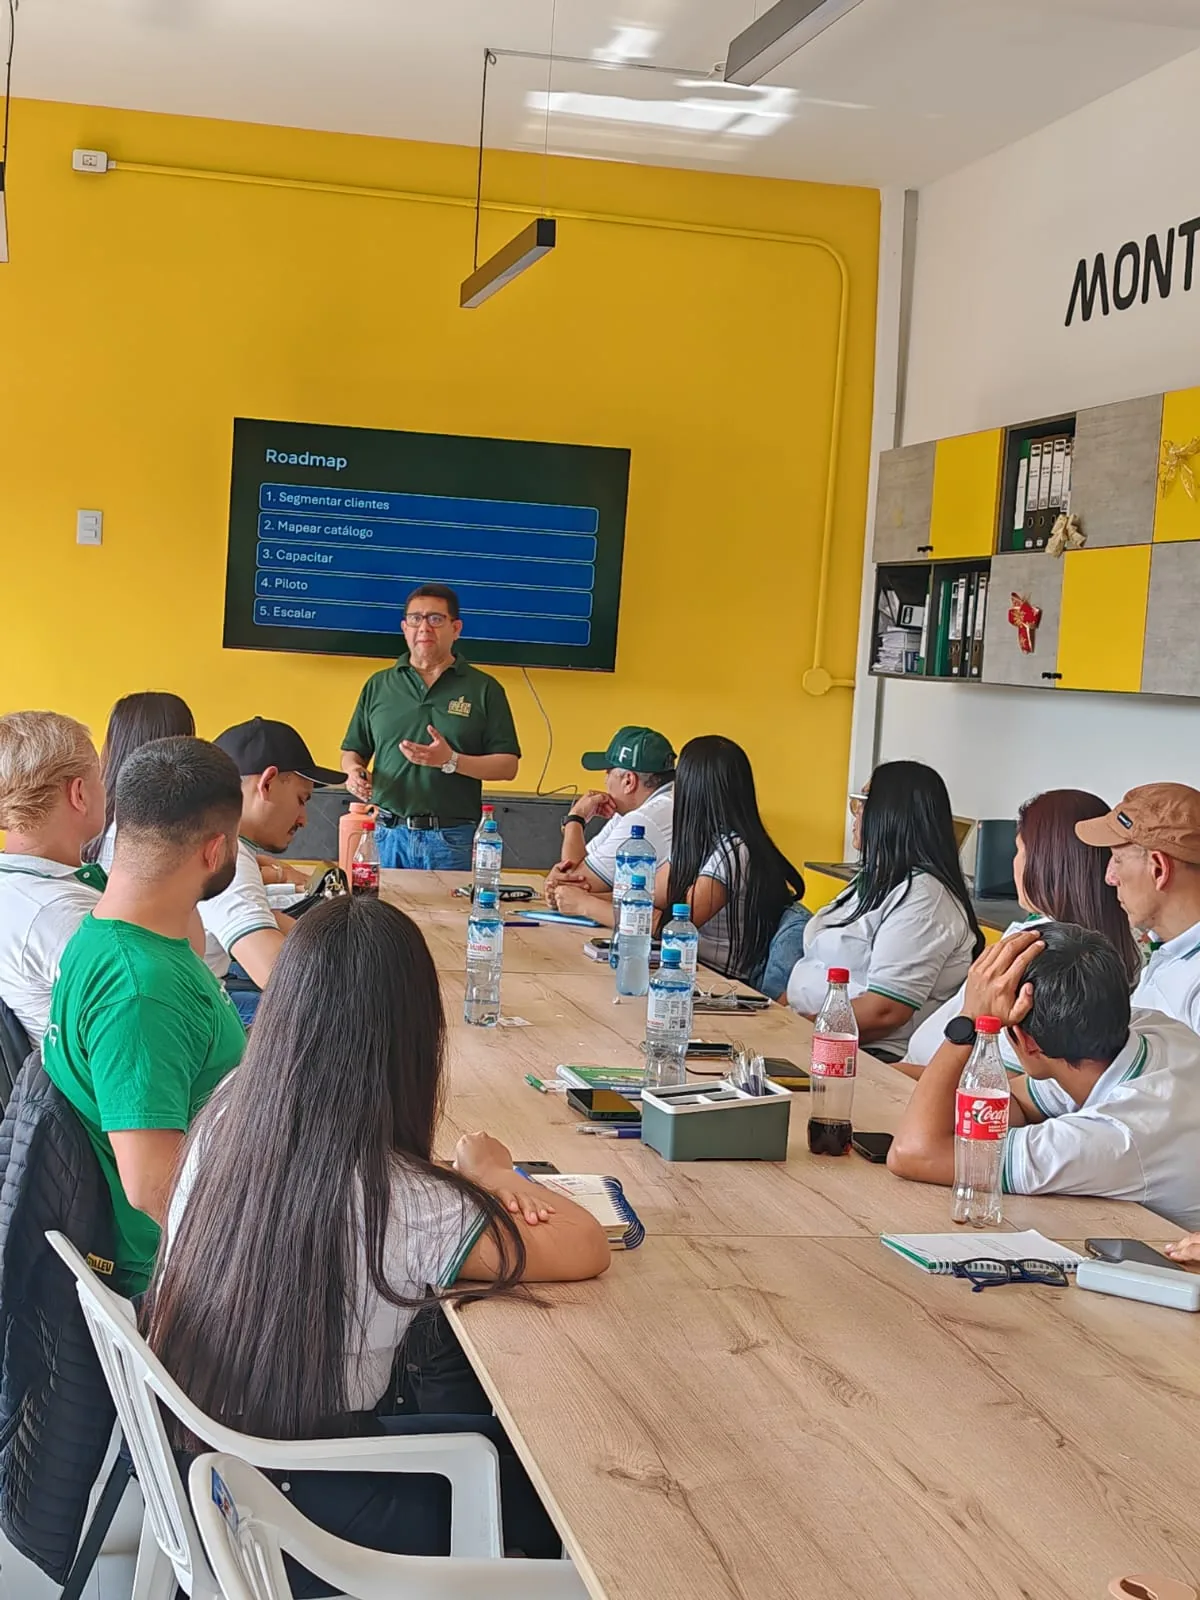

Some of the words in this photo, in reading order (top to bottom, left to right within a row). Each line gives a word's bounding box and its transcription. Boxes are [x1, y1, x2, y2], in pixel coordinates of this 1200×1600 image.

[1064, 216, 1200, 327] MONT
[265, 449, 348, 471] Roadmap
[266, 491, 276, 502] 1.
[278, 492, 341, 506] Segmentar
[344, 498, 390, 510] clientes
[263, 520, 275, 531] 2.
[277, 521, 322, 534] Mapear
[323, 523, 374, 539] catálogo
[262, 549, 273, 560] 3.
[275, 549, 334, 563] Capacitar
[260, 577, 272, 588] 4.
[274, 578, 308, 590] Piloto
[259, 606, 271, 617] 5.
[273, 606, 317, 619] Escalar
